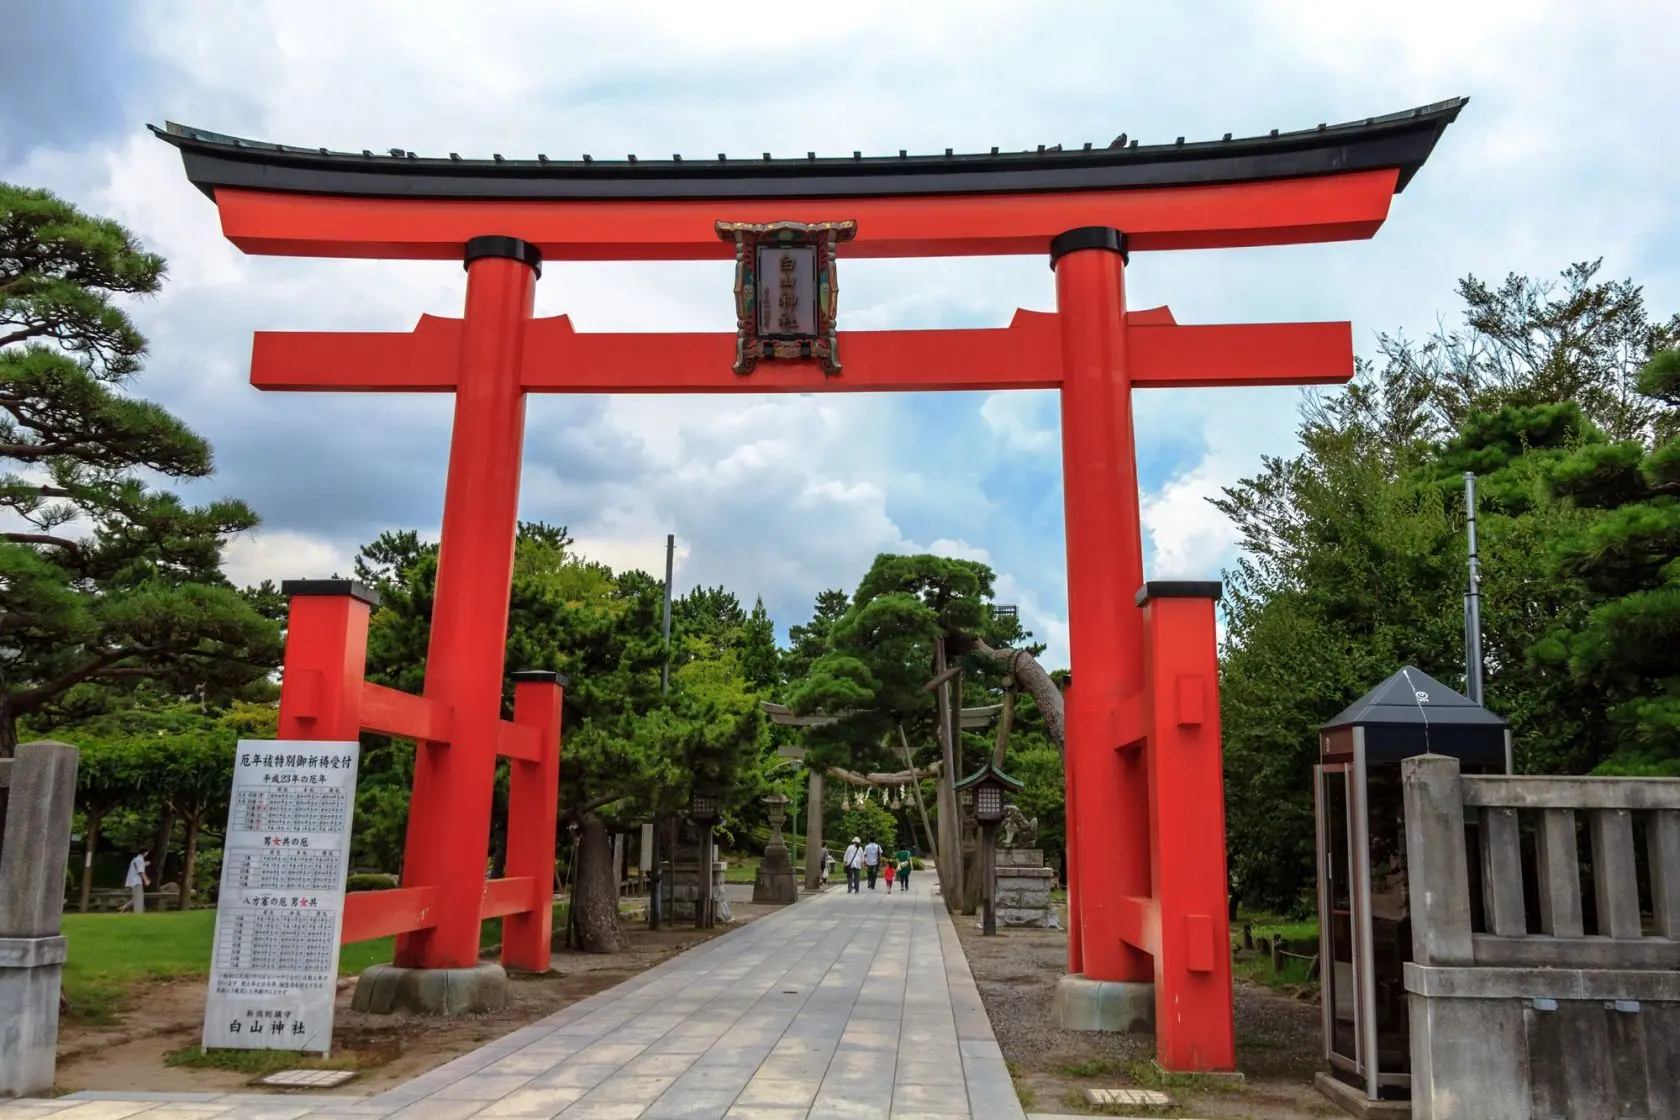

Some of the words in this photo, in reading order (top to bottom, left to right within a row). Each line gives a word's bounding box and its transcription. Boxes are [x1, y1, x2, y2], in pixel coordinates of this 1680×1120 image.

[263, 774, 327, 784] 平成23年の厄年
[263, 836, 309, 847] 男女共の厄
[291, 897, 318, 908] 男女共
[230, 1019, 306, 1034] 白山神社
